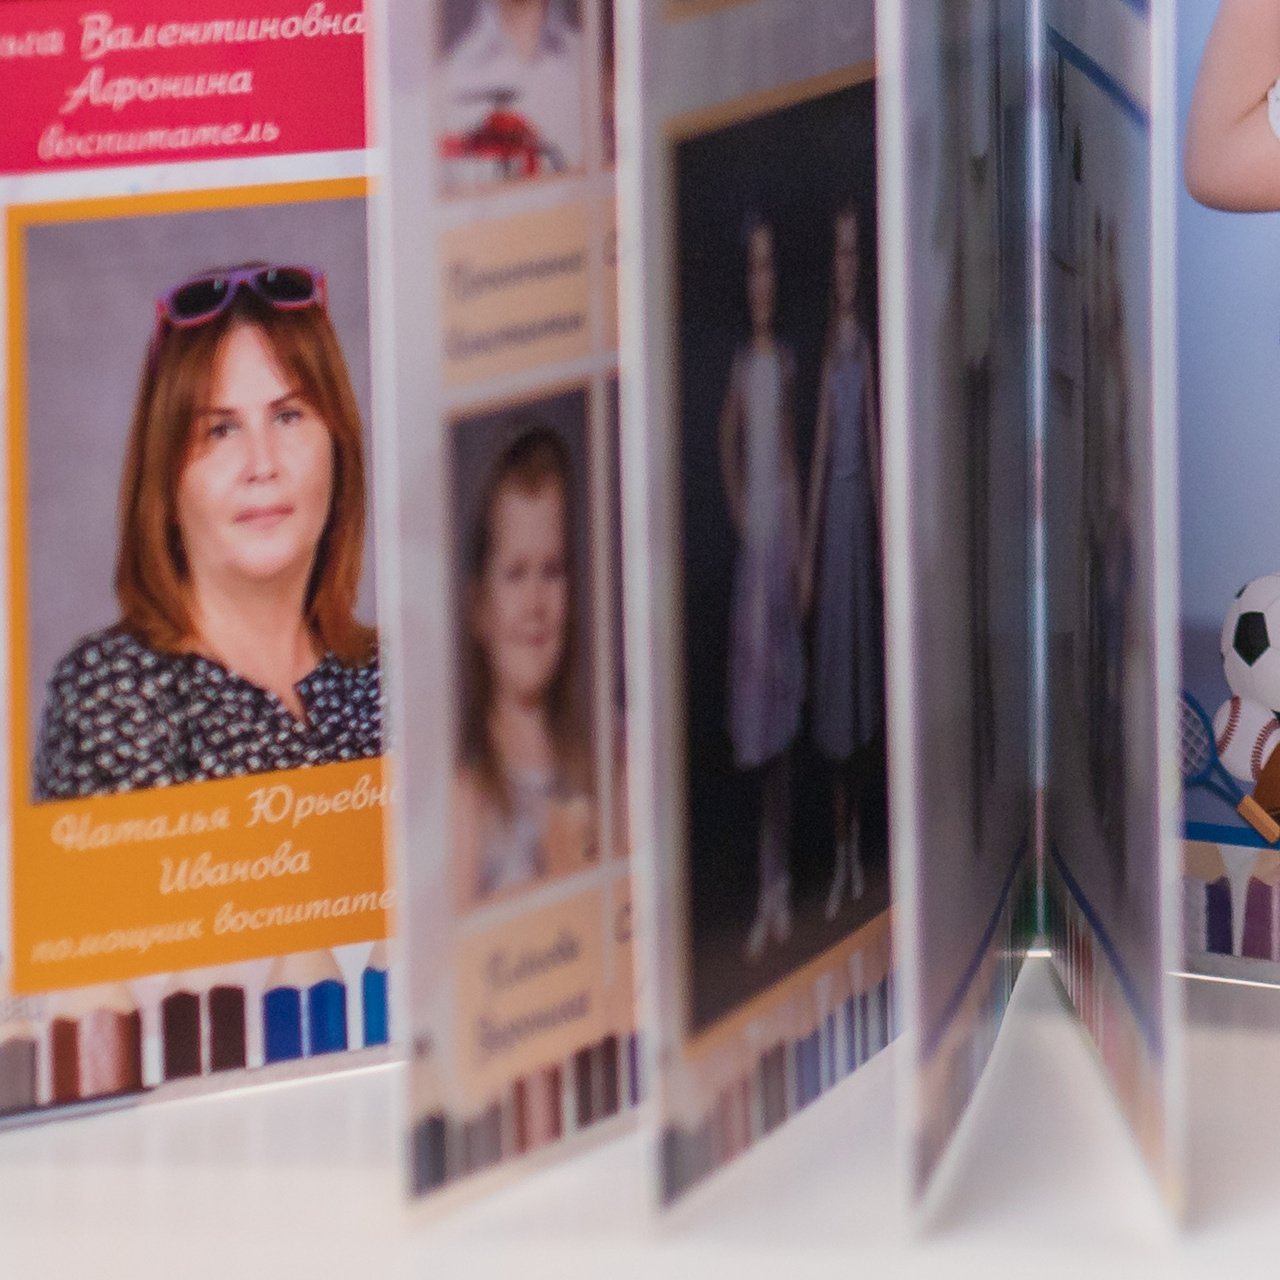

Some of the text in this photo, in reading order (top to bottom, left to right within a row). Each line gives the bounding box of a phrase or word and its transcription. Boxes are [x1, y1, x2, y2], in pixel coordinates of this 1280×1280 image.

[79, 1, 366, 62] Валентиновна
[38, 121, 280, 160] воспитатель
[50, 805, 231, 852] Наталья
[158, 839, 312, 894] Иванова
[30, 917, 205, 964] помощник
